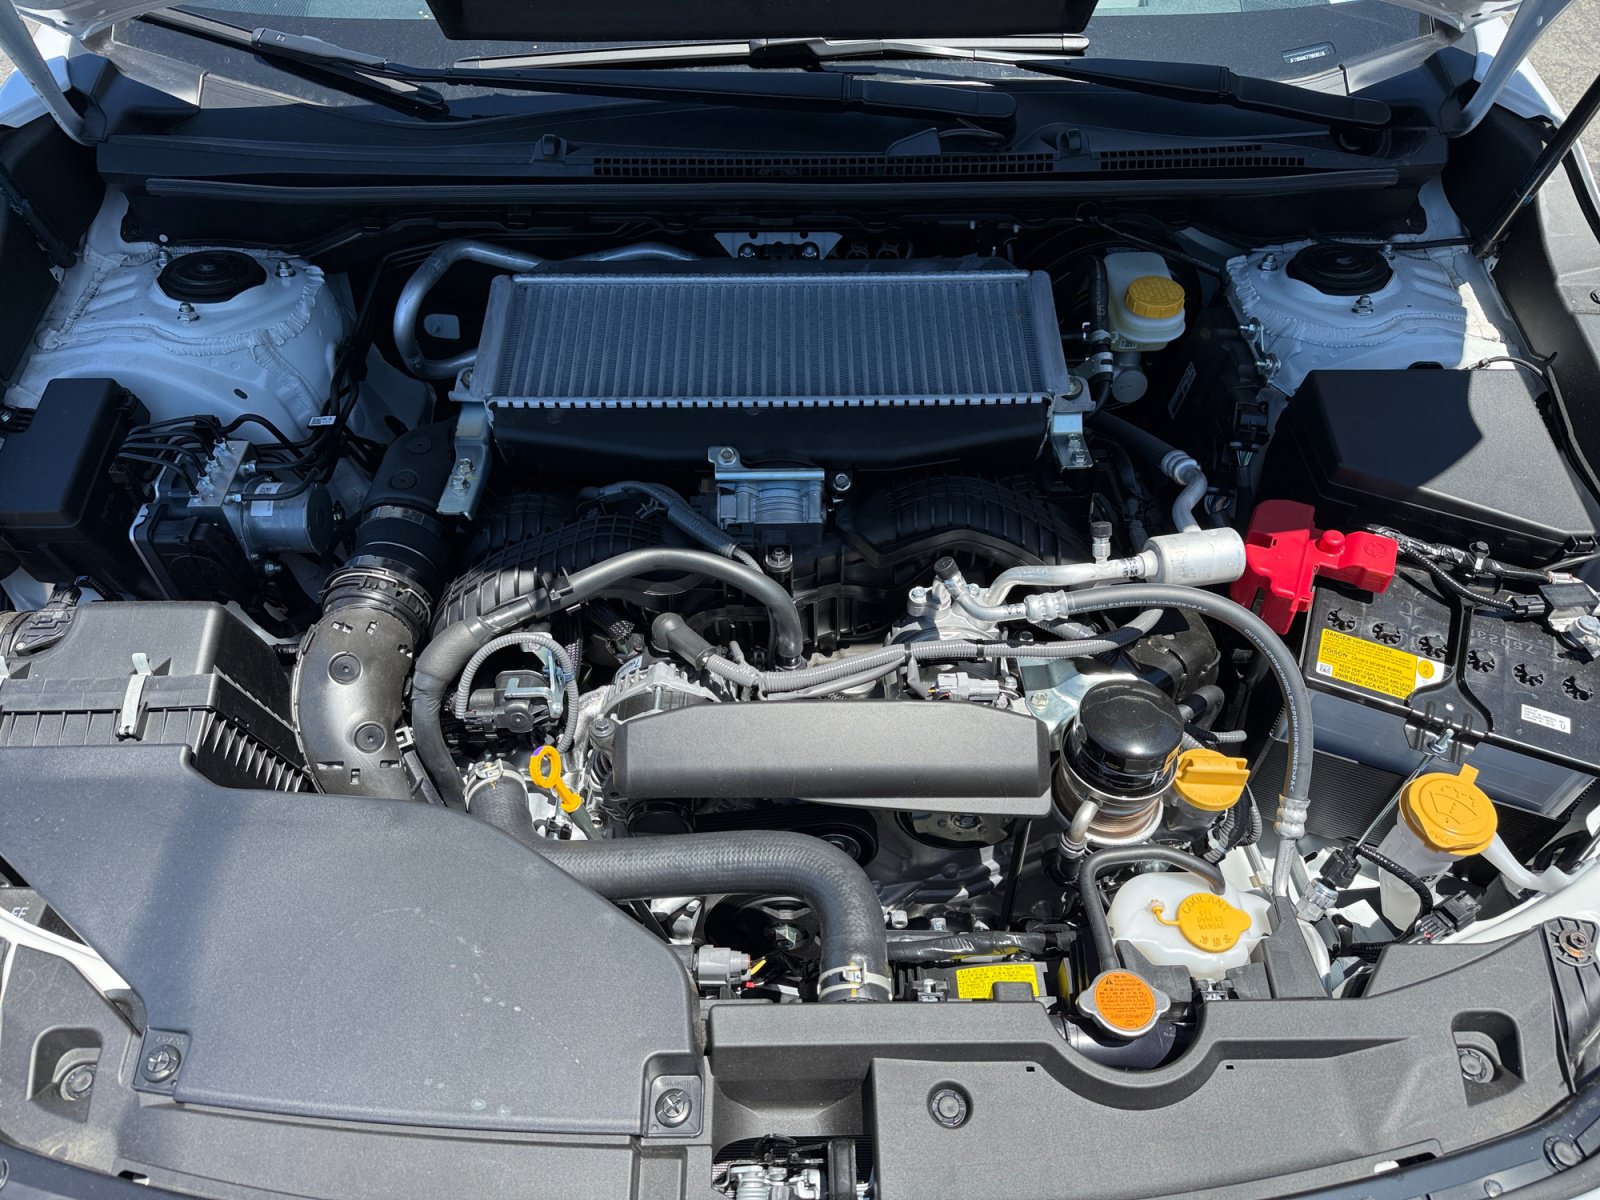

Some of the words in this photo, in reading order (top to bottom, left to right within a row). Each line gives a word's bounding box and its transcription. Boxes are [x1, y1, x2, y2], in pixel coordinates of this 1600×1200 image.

[1324, 630, 1352, 642] DANGER
[1322, 646, 1348, 658] POISON
[1182, 896, 1232, 914] COOLANT
